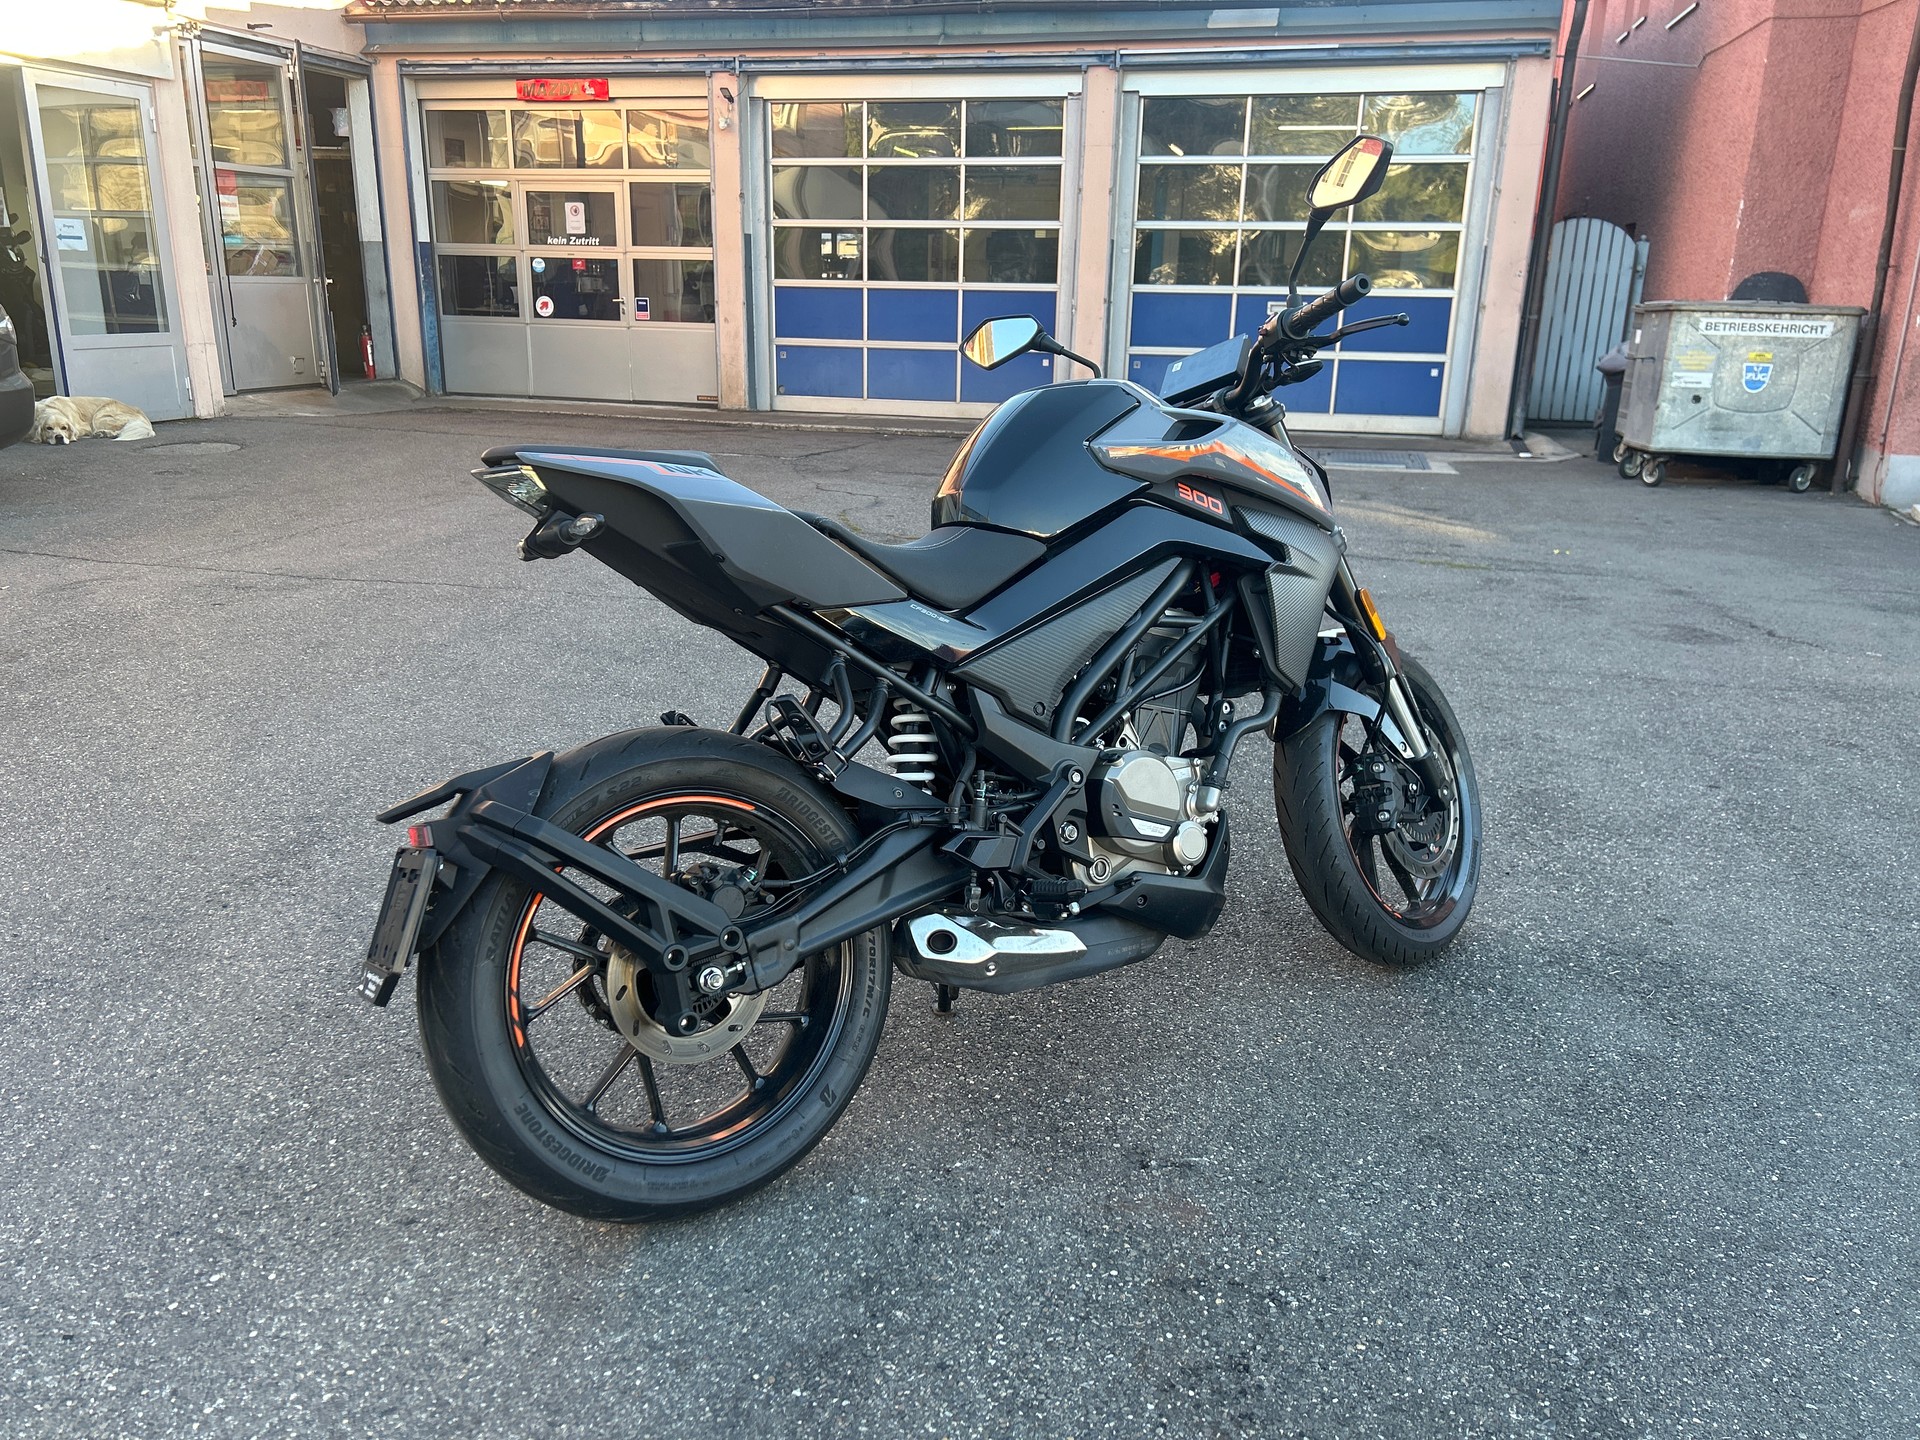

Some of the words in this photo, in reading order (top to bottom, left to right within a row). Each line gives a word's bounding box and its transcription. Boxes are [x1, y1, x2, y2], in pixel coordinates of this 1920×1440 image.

[522, 82, 581, 97] MAZDA
[547, 236, 567, 245] kein
[569, 236, 600, 246] Zutritt
[1704, 321, 1827, 335] BETRIEBSKEHRICHT
[1177, 482, 1223, 515] 300
[514, 1102, 611, 1184] BRIDGESTONE
